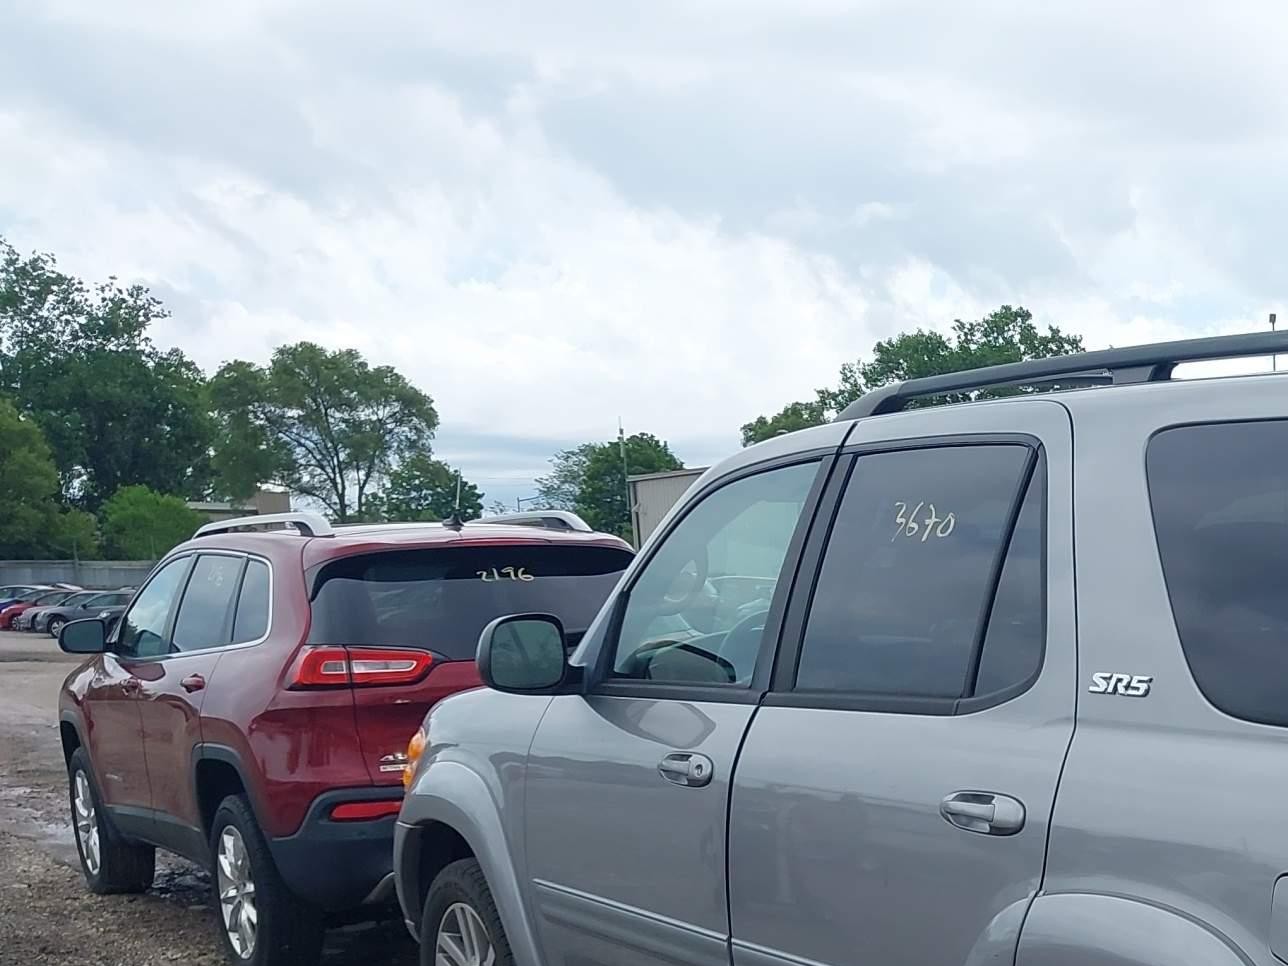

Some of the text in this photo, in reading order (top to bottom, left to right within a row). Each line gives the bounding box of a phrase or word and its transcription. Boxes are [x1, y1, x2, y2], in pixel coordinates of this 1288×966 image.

[891, 501, 956, 542] 3670
[475, 566, 535, 582] 2196
[1088, 672, 1153, 698] SR5
